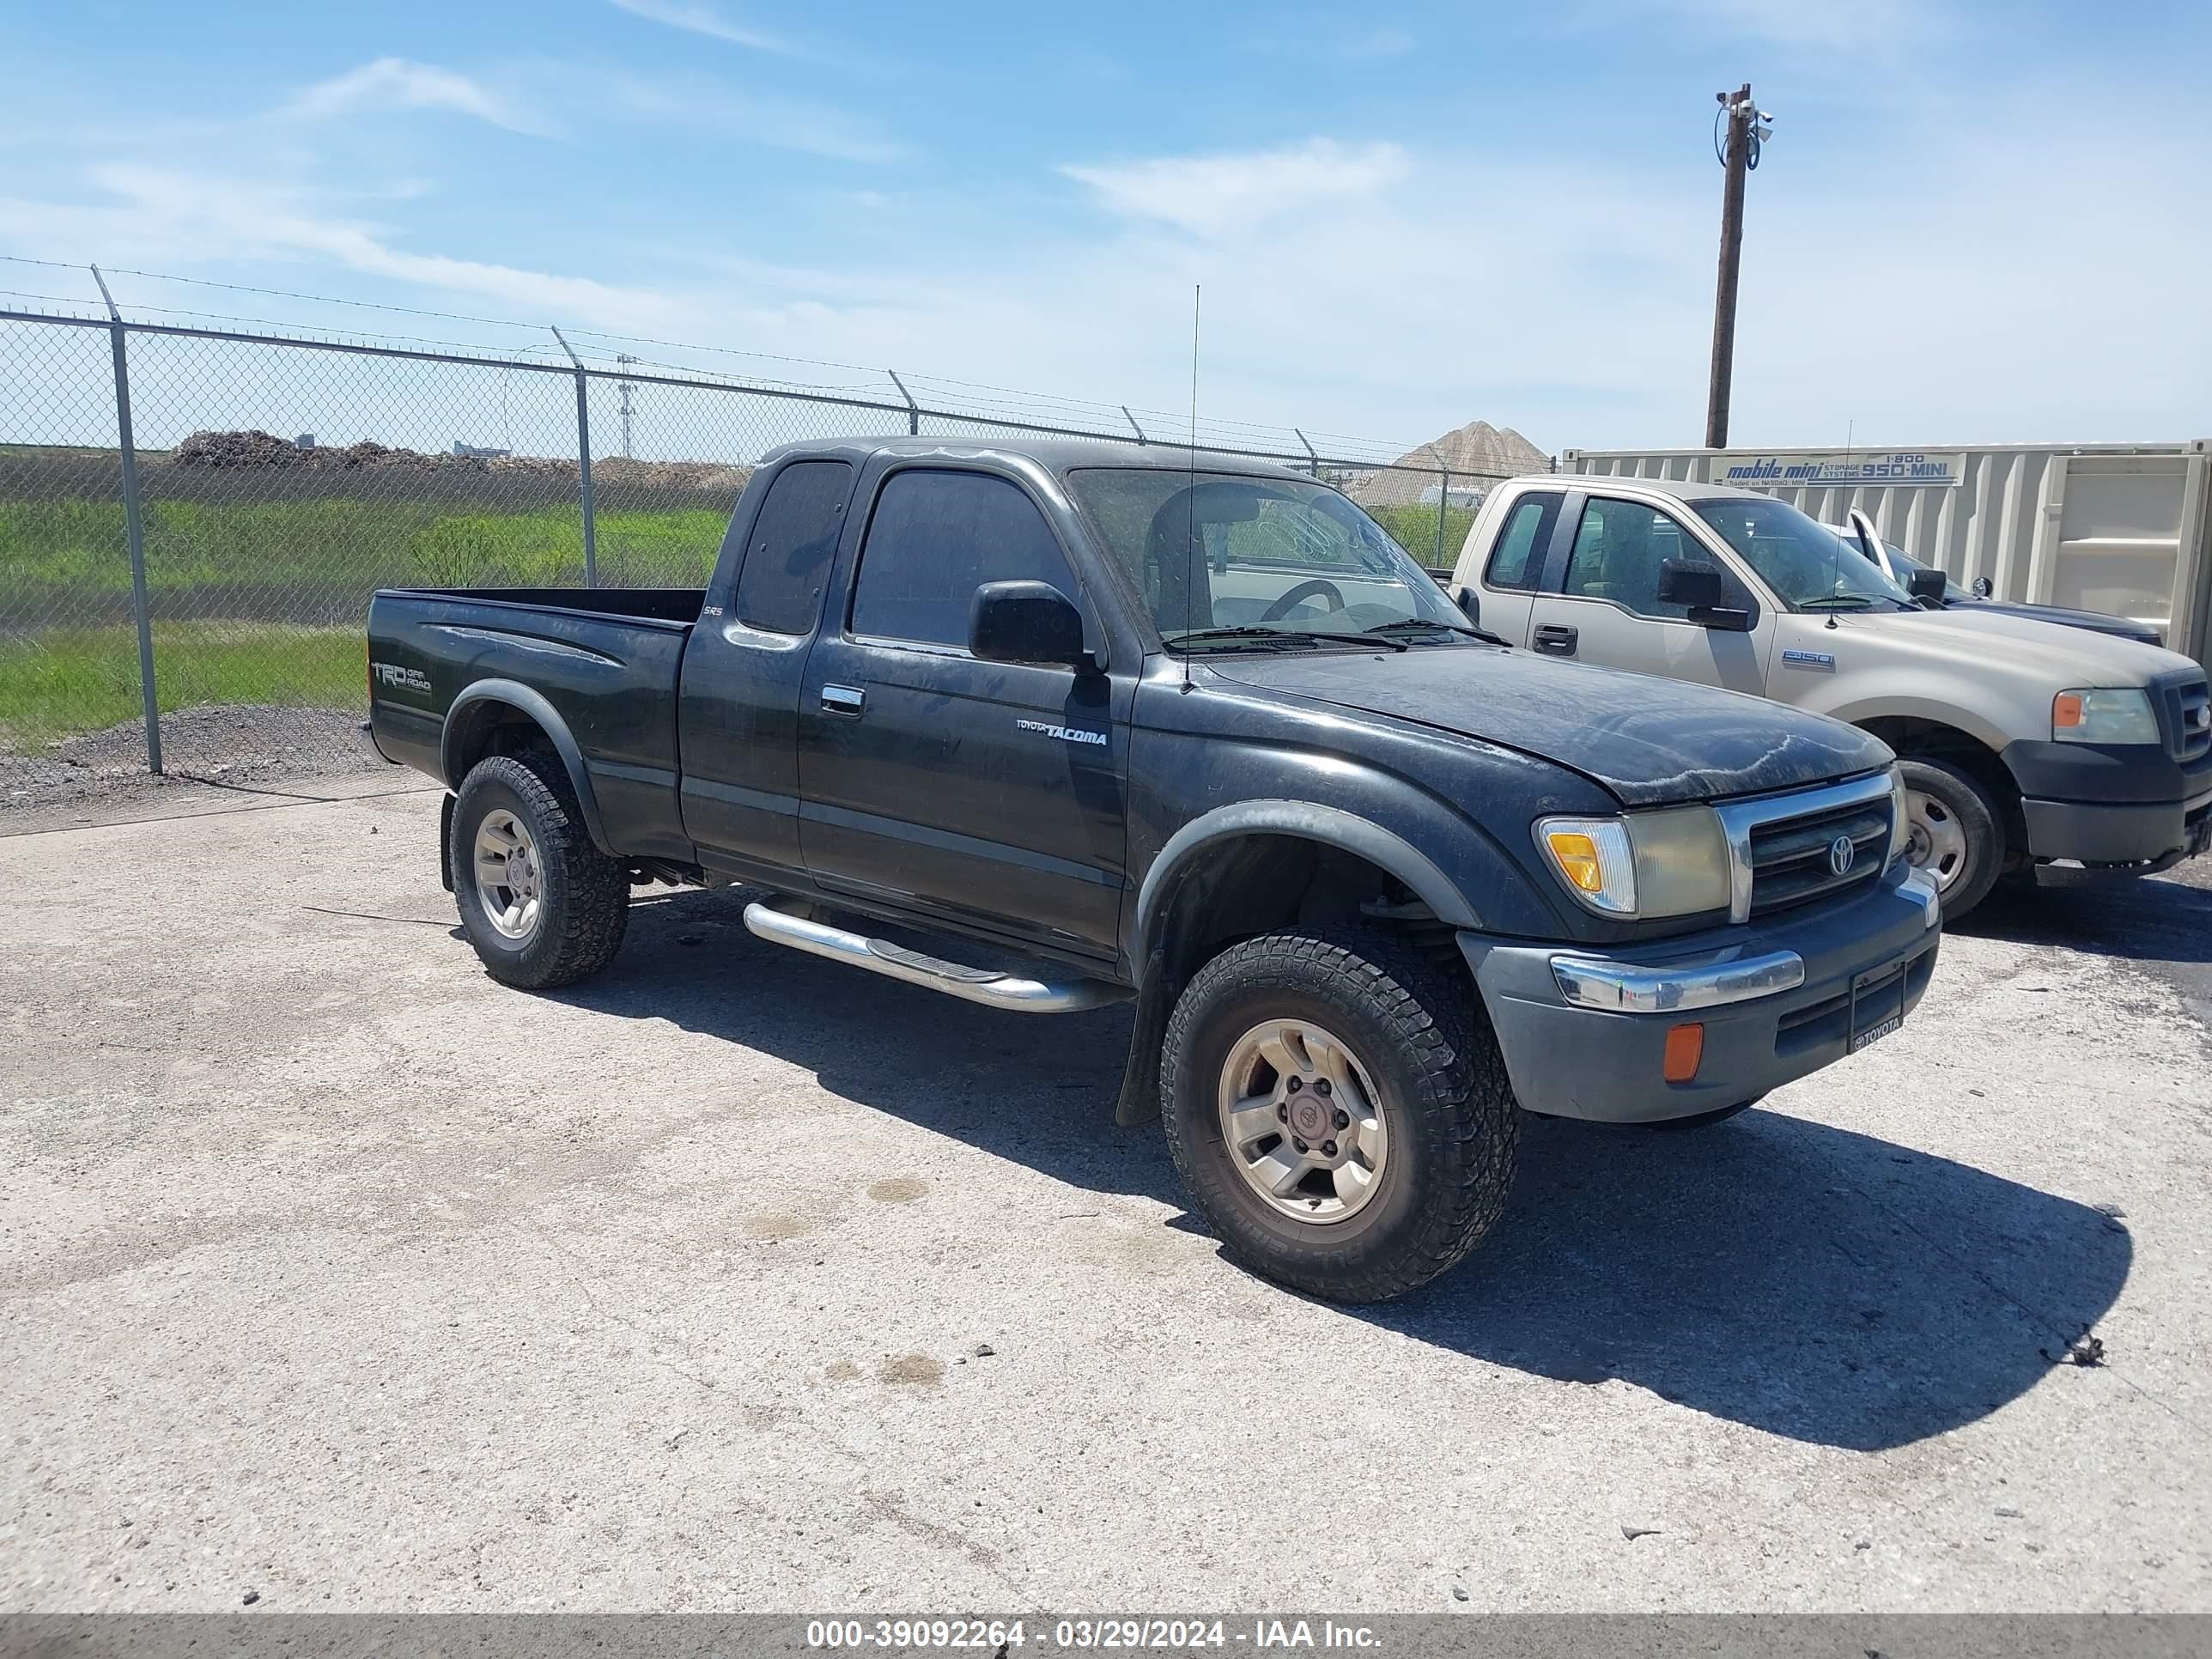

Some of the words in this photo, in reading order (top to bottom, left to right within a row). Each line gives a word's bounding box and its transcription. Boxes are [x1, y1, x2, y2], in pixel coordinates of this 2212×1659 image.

[1727, 459, 1784, 478] mobile
[1784, 463, 1824, 478] mini
[1862, 463, 1948, 477] 950-MINI
[371, 662, 406, 686] TRD
[407, 678, 431, 690] ROAD
[1017, 720, 1047, 732] TOYOTA
[1045, 725, 1108, 746] TACOMA
[1864, 1018, 1900, 1045] TOYOTA
